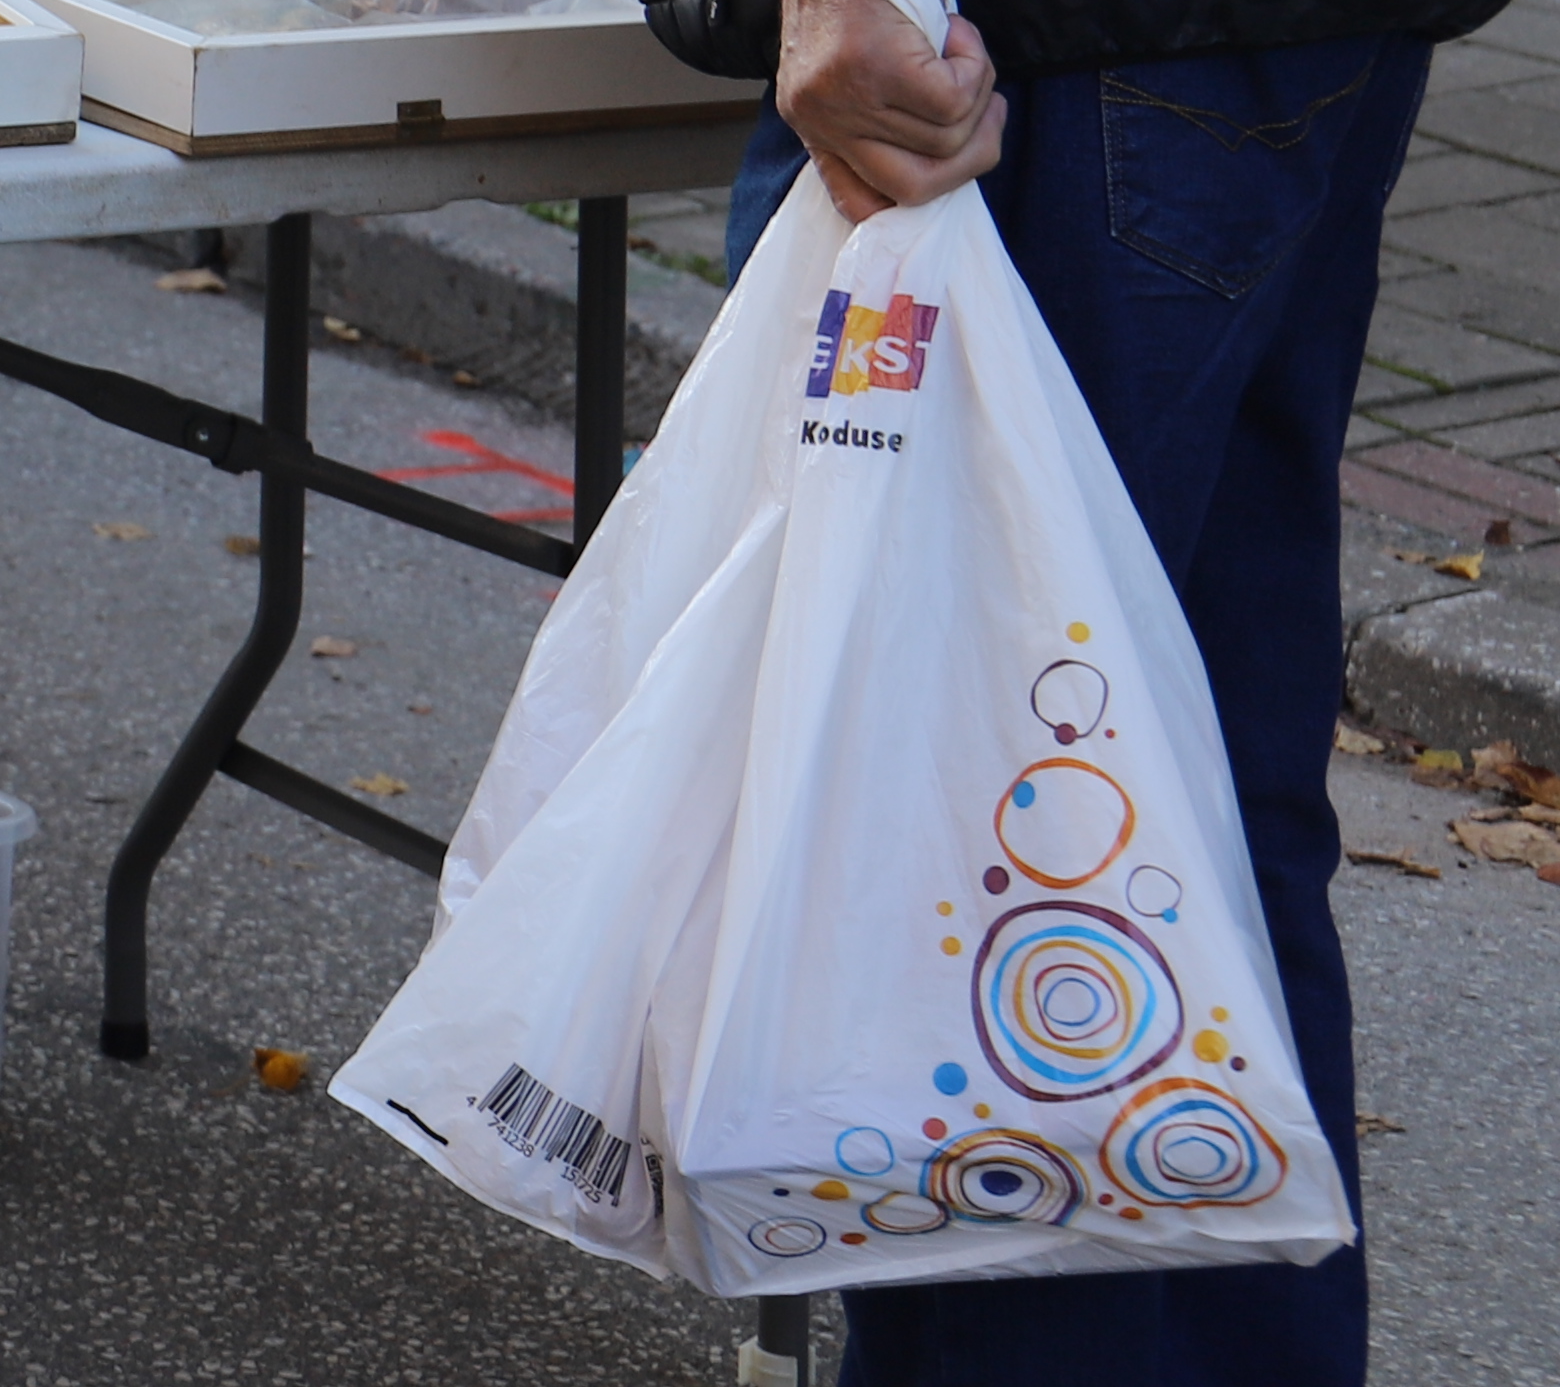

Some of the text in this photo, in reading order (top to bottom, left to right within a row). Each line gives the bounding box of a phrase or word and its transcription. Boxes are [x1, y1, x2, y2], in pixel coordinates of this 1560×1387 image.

[813, 334, 932, 375] EKS
[800, 419, 903, 453] Koduse
[487, 1115, 535, 1158] 741238
